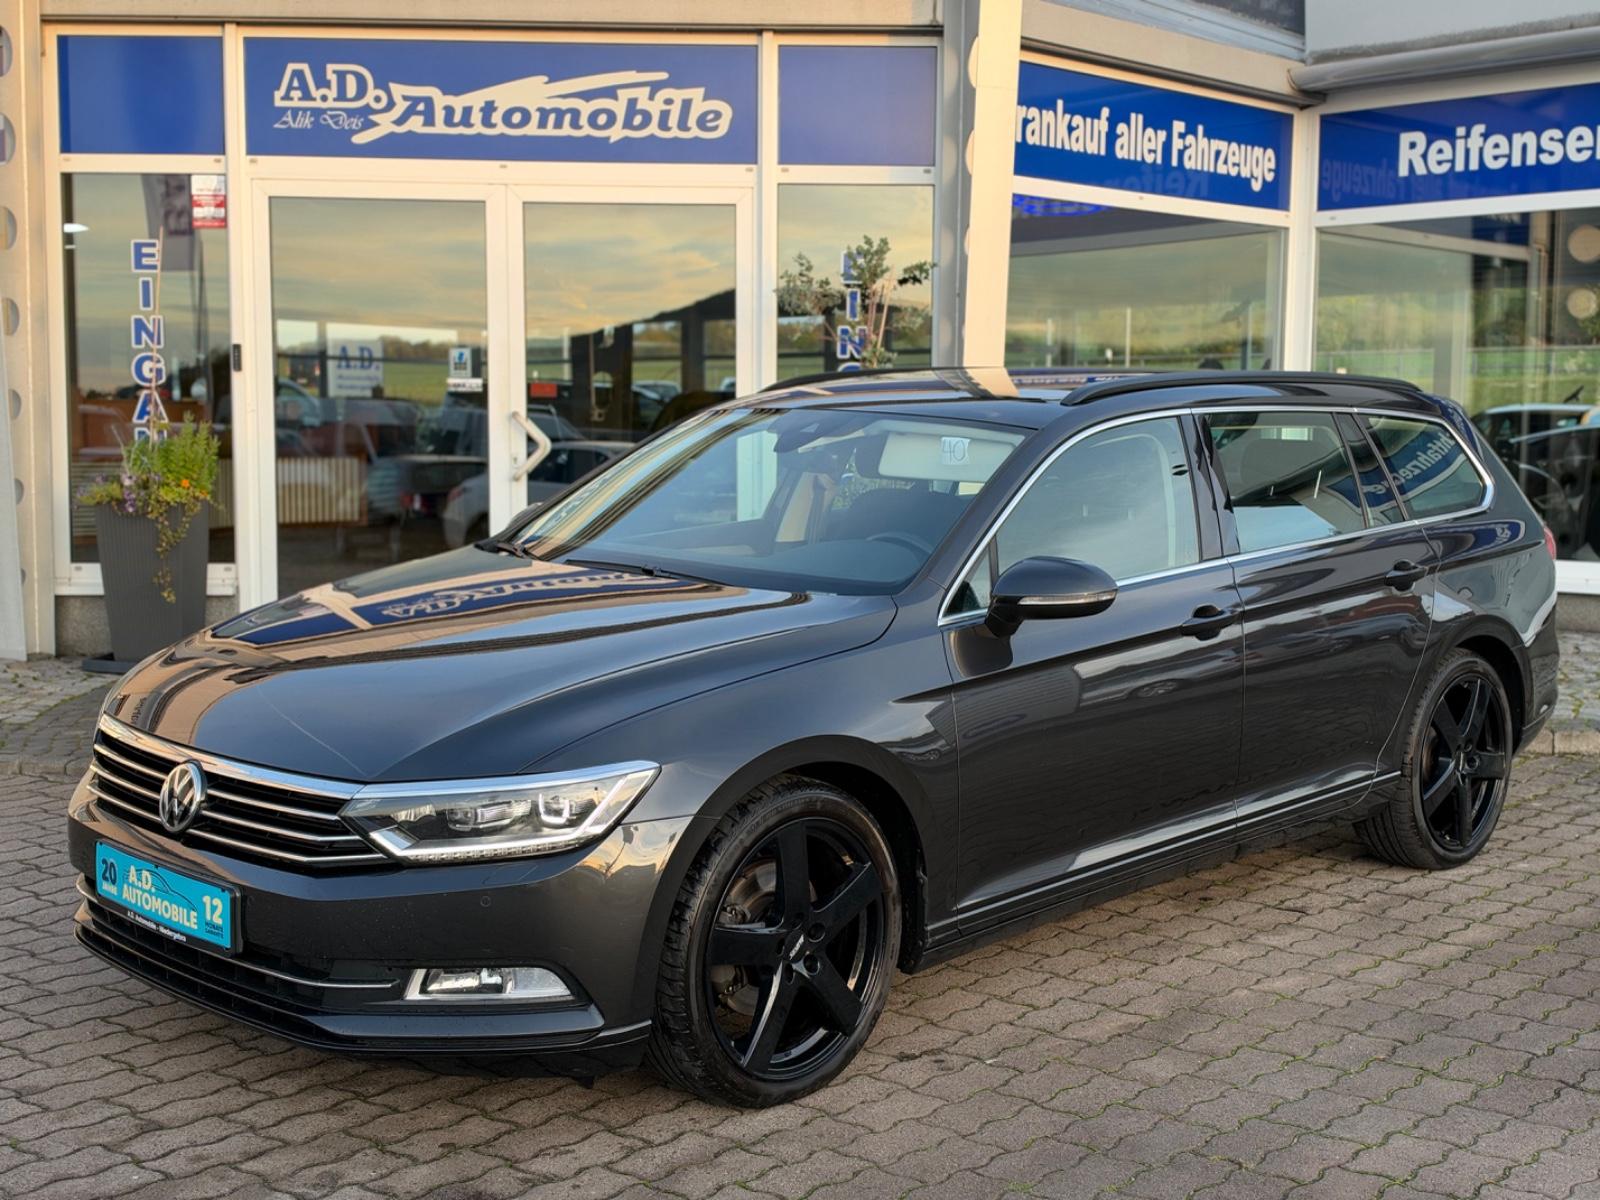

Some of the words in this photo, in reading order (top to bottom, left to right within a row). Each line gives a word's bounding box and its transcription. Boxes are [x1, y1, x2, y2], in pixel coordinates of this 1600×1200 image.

[273, 109, 315, 129] Alik
[274, 62, 388, 110] A.D.
[390, 88, 731, 139] Automobile
[1114, 112, 1167, 165] aller
[1171, 119, 1276, 192] Fahrzeuge
[1397, 123, 1600, 178] Reifense
[101, 857, 118, 886] 20
[128, 865, 155, 892] A.D.
[122, 883, 198, 930] AUTOMOBILE
[202, 895, 223, 925] 12
